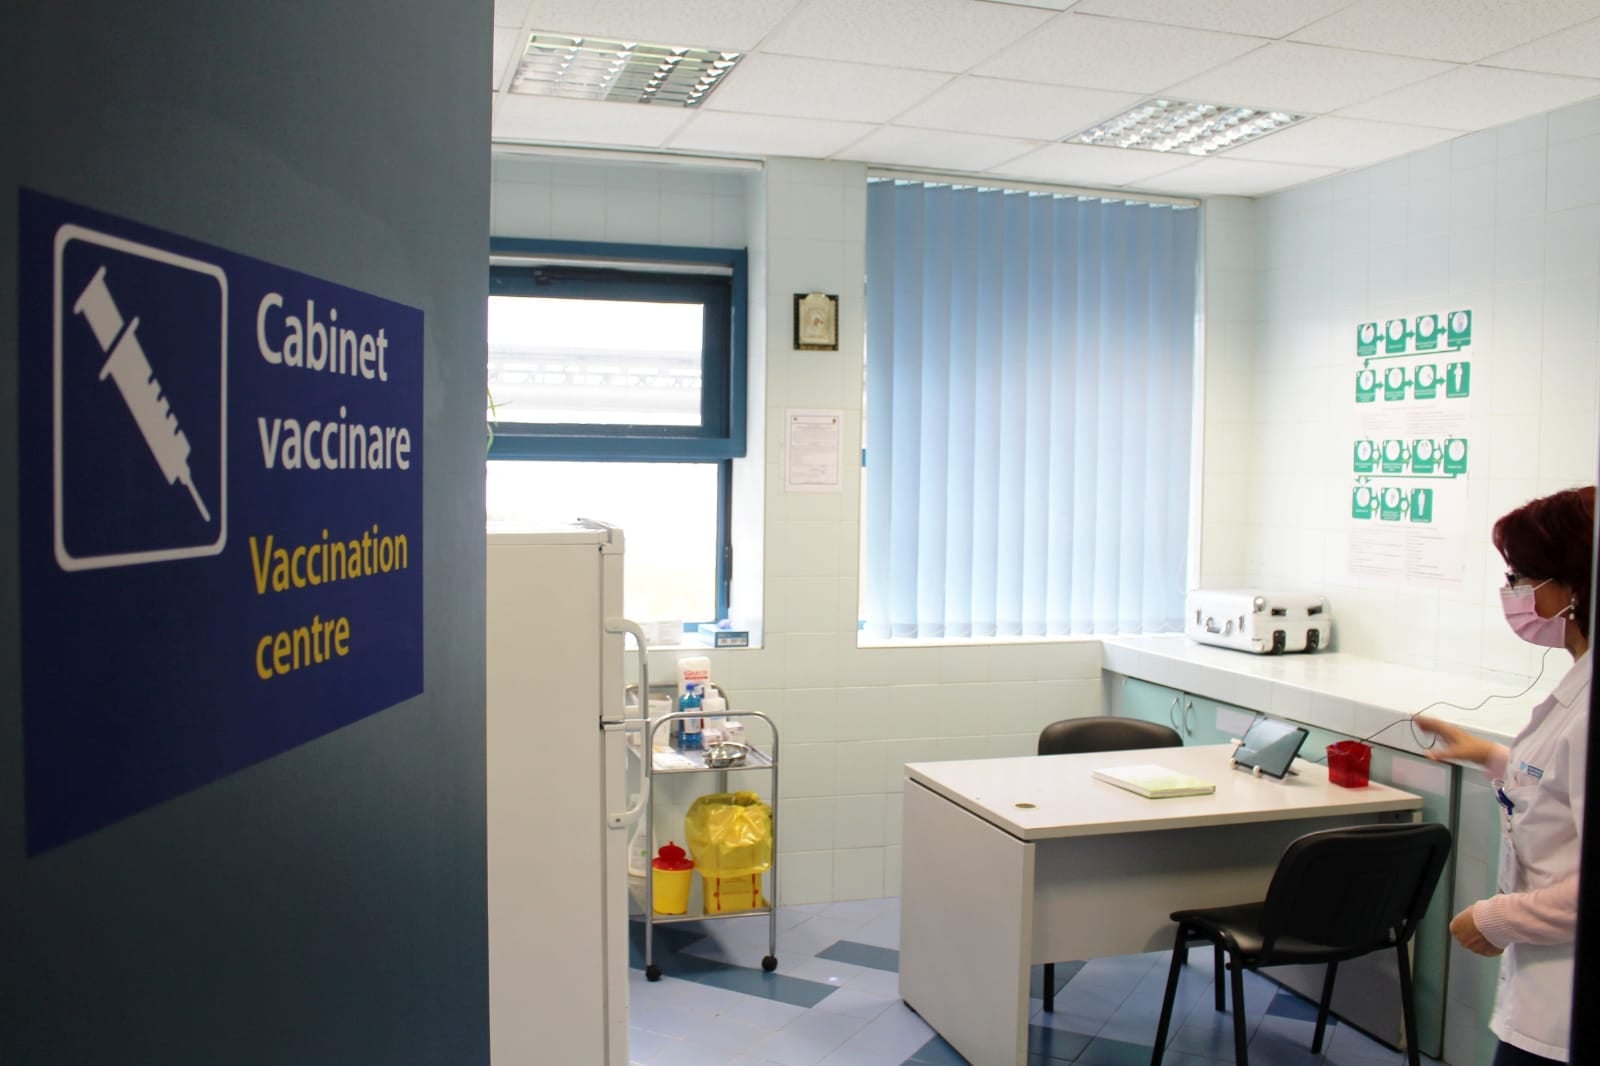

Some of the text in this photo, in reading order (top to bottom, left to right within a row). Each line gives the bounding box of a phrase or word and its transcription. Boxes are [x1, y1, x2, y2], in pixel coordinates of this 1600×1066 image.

[256, 292, 388, 382] Cabinet
[257, 406, 411, 470] vaccinare
[249, 524, 408, 595] Vaccination
[256, 615, 350, 680] centre
